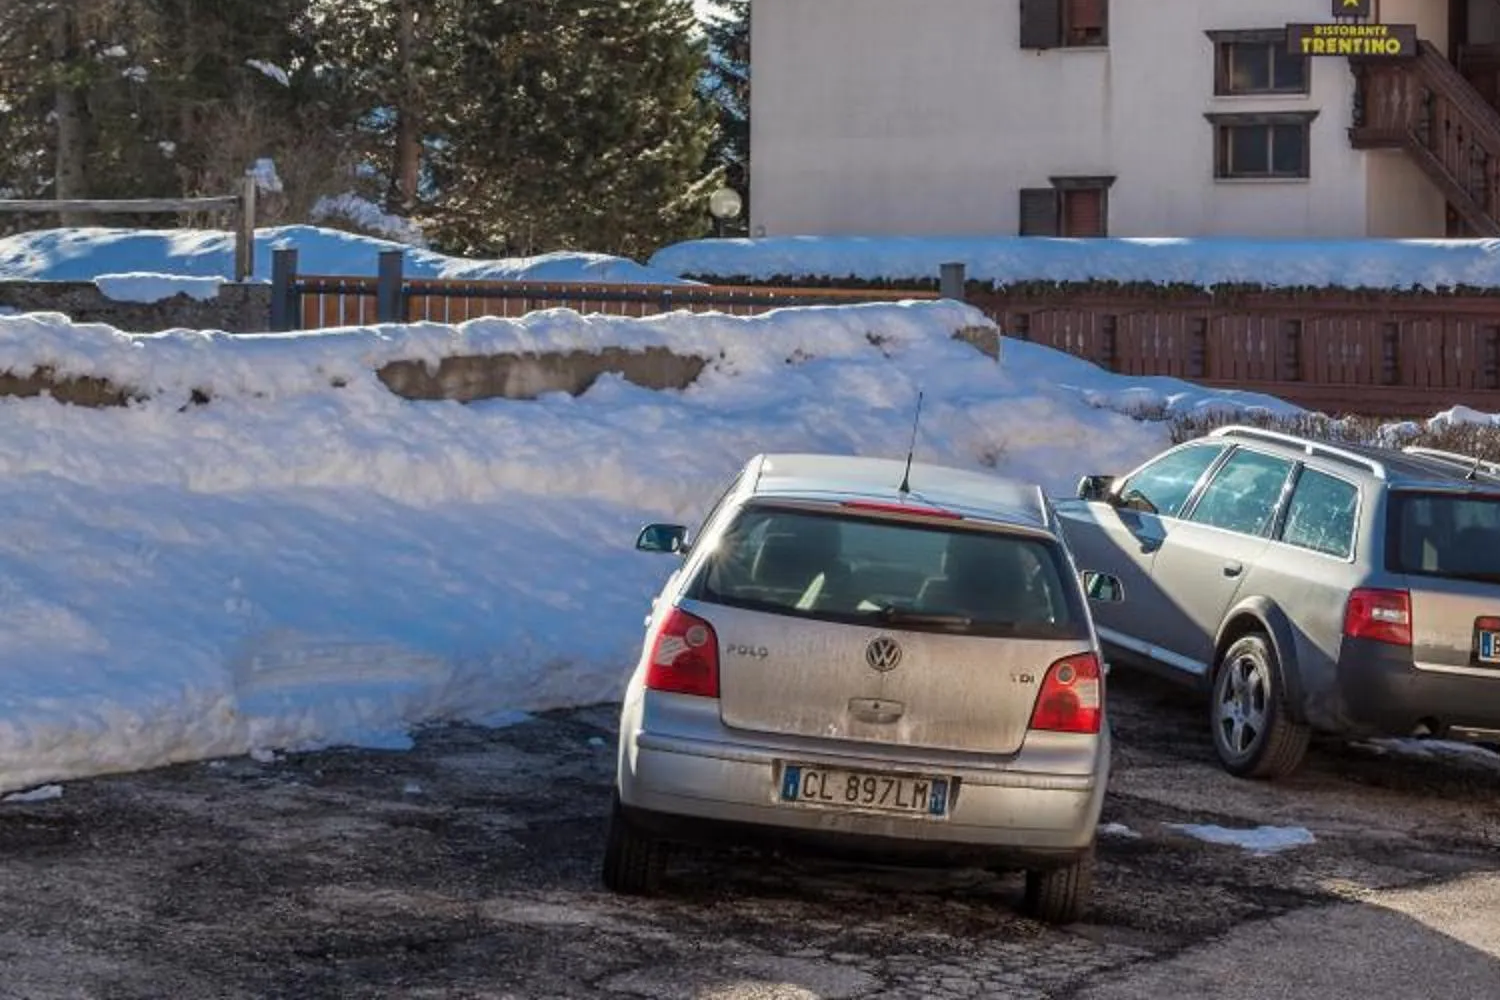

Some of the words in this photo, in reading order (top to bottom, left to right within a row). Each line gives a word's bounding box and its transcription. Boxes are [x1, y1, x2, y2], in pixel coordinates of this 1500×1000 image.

[1313, 25, 1388, 36] RISTORANTE
[1301, 37, 1401, 55] TRENTINO
[726, 643, 769, 658] POLO
[803, 772, 833, 801] CL
[845, 776, 928, 809] 897LM
